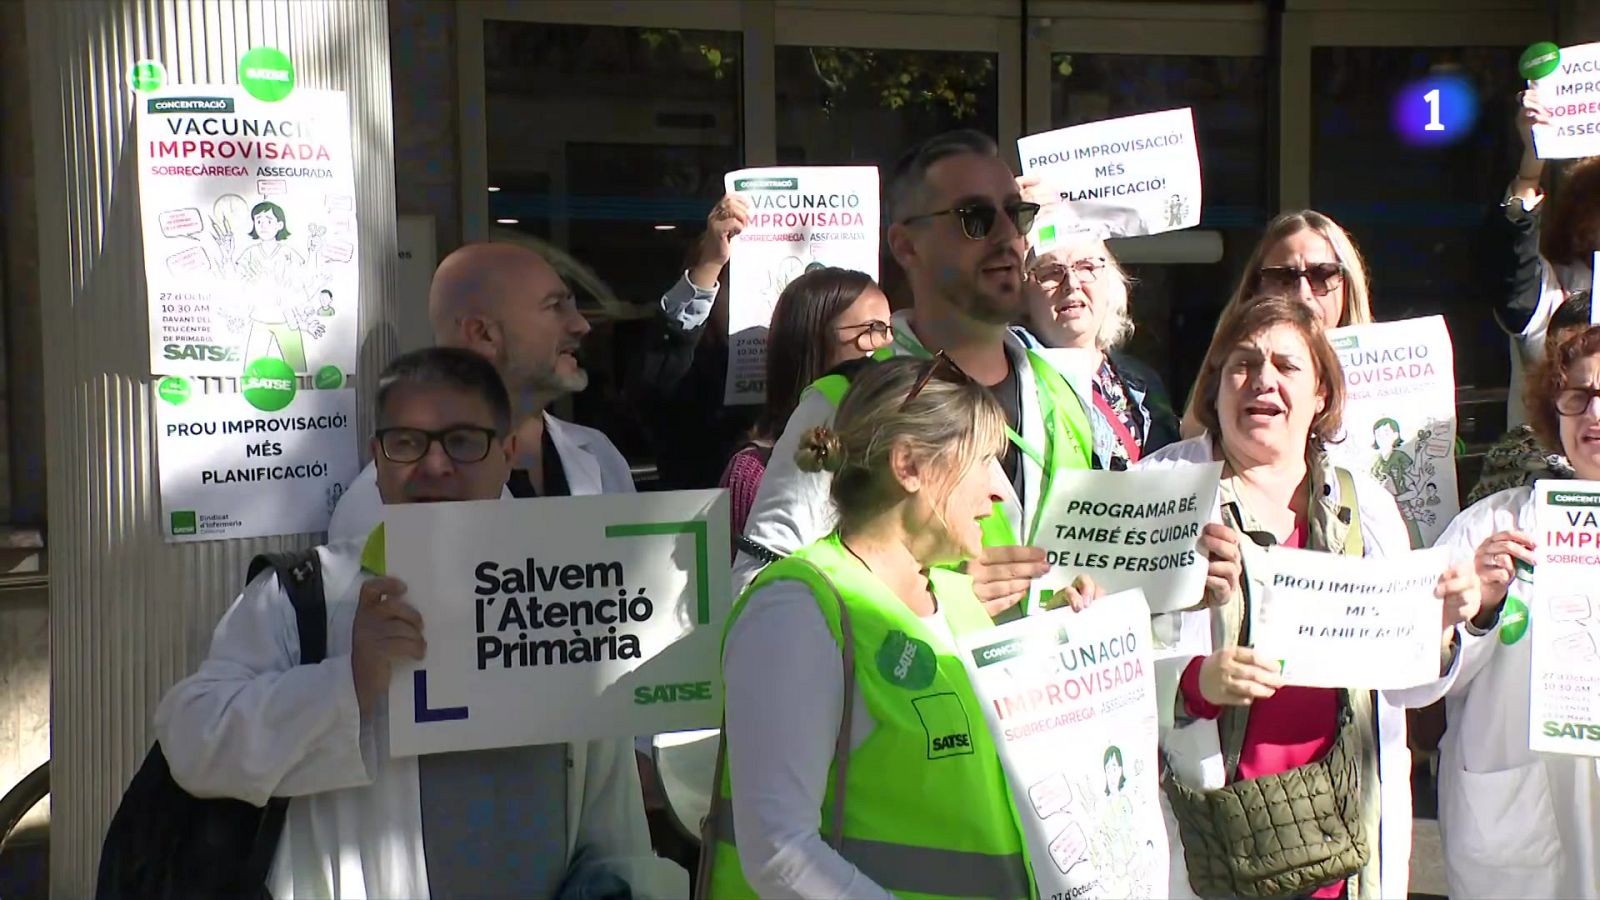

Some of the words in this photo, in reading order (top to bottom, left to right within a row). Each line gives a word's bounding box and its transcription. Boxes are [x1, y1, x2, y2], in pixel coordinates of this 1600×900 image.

[155, 99, 226, 110] CONCENTRACIÓ
[1545, 103, 1600, 117] SOBRE
[166, 117, 312, 138] VACUNACI
[149, 140, 331, 161] IMPROVISADA
[1028, 152, 1070, 169] PROU
[1074, 131, 1184, 160] IMPROVISACIÓ!
[151, 163, 249, 177] SOBRECÀRREGA
[256, 165, 334, 178] ASSEGURADA
[1094, 162, 1126, 179] MÉS
[751, 190, 860, 209] VACUNACIÓ
[1059, 176, 1167, 202] PLANIFICACIÓ!
[745, 212, 865, 228] MPROVISADA
[159, 292, 172, 302] 27
[166, 421, 217, 437] PROU
[222, 412, 348, 435] IMPROVISACIÓ!
[246, 440, 283, 458] MÉS
[201, 460, 329, 485] PLANIFICACIÓ!
[1067, 498, 1175, 519] PROGRAMAR
[1055, 524, 1122, 544] TAMBÉ
[1124, 527, 1147, 546] ÉS
[1149, 522, 1199, 545] CUIDAR
[1046, 550, 1071, 567] DE
[1073, 552, 1110, 569] LES
[1113, 549, 1196, 572] PERSONES
[474, 557, 624, 596] Salvem
[1273, 573, 1324, 592] PROU
[475, 587, 654, 634] l'Atenció
[477, 627, 642, 671] Primària
[893, 639, 918, 681] SATSE
[633, 681, 713, 706] SATSE
[993, 658, 1144, 721] IMPROVISADA
[933, 733, 970, 751] SATSE
